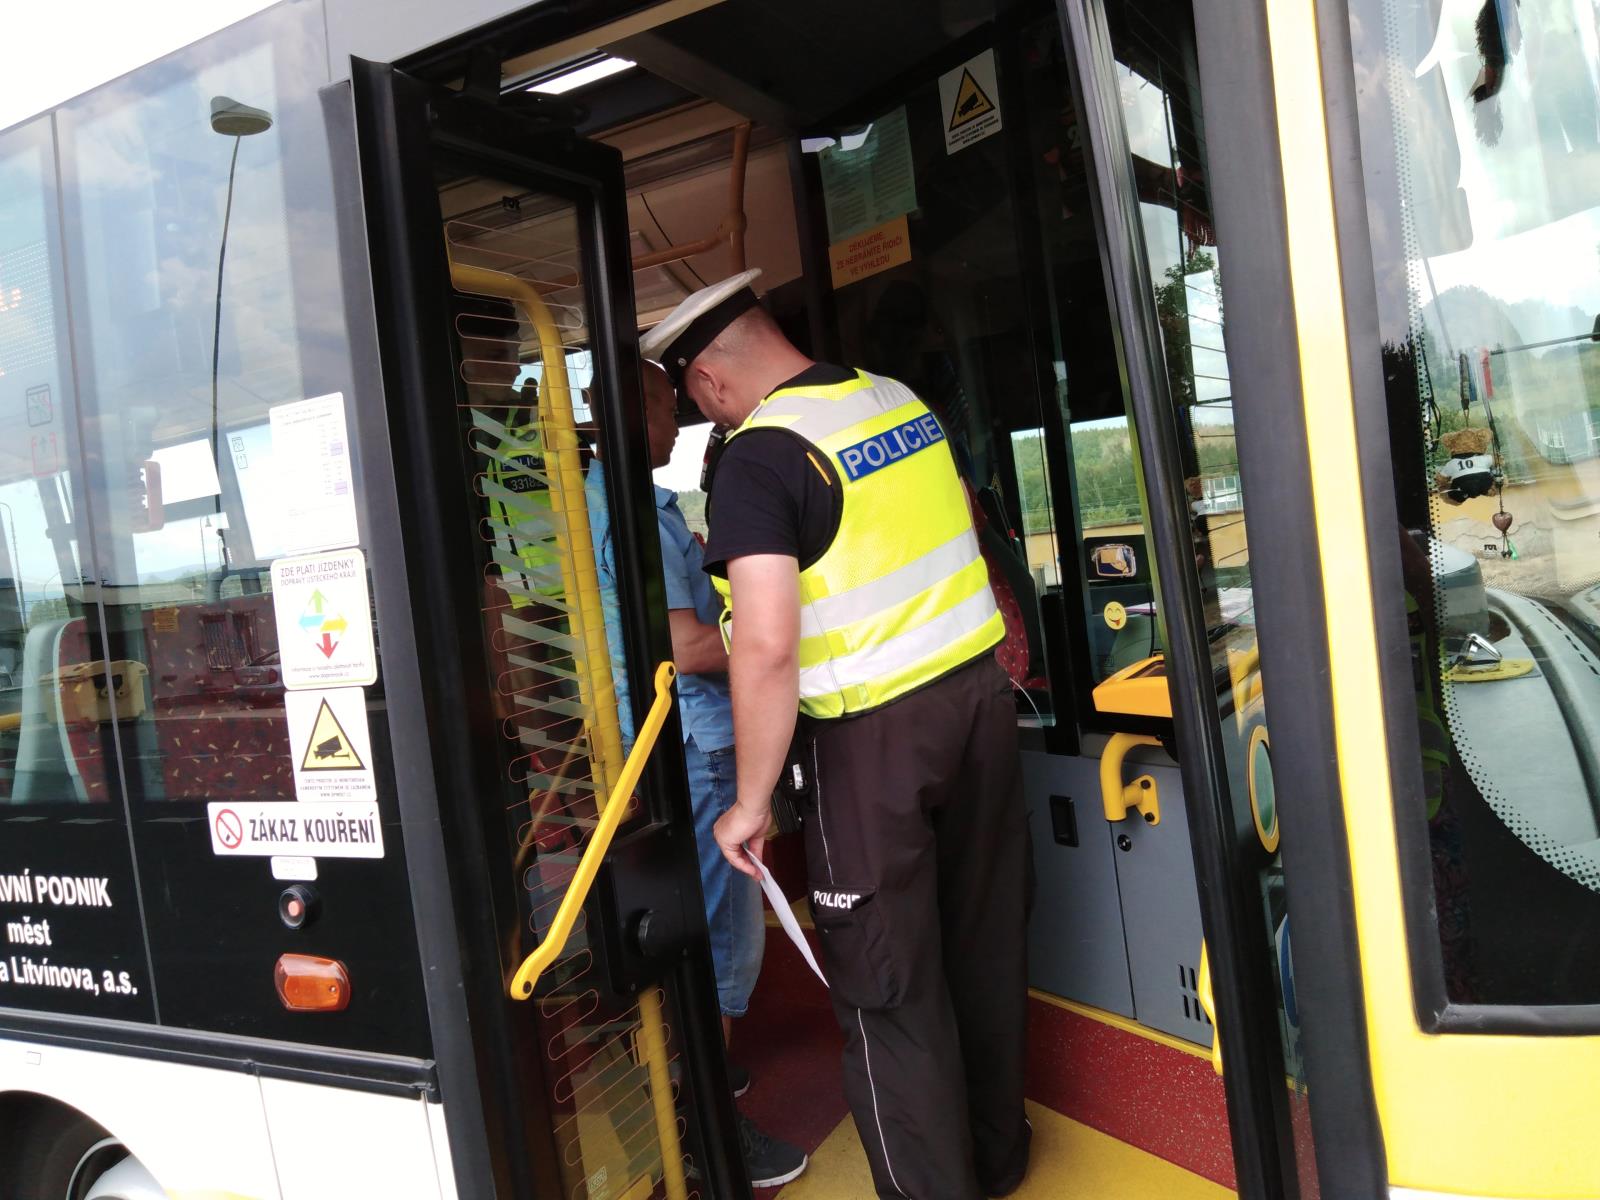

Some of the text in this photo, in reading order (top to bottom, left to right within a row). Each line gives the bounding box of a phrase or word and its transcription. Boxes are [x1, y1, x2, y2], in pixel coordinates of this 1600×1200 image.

[842, 415, 942, 477] POLICIE
[1457, 459, 1474, 471] 10
[249, 811, 376, 844] ZÁKAZ KOUŘENÍ
[34, 875, 113, 907] PODNIK
[7, 916, 52, 946] měst
[11, 956, 99, 996] Litvínova,
[102, 970, 138, 995] a.s.
